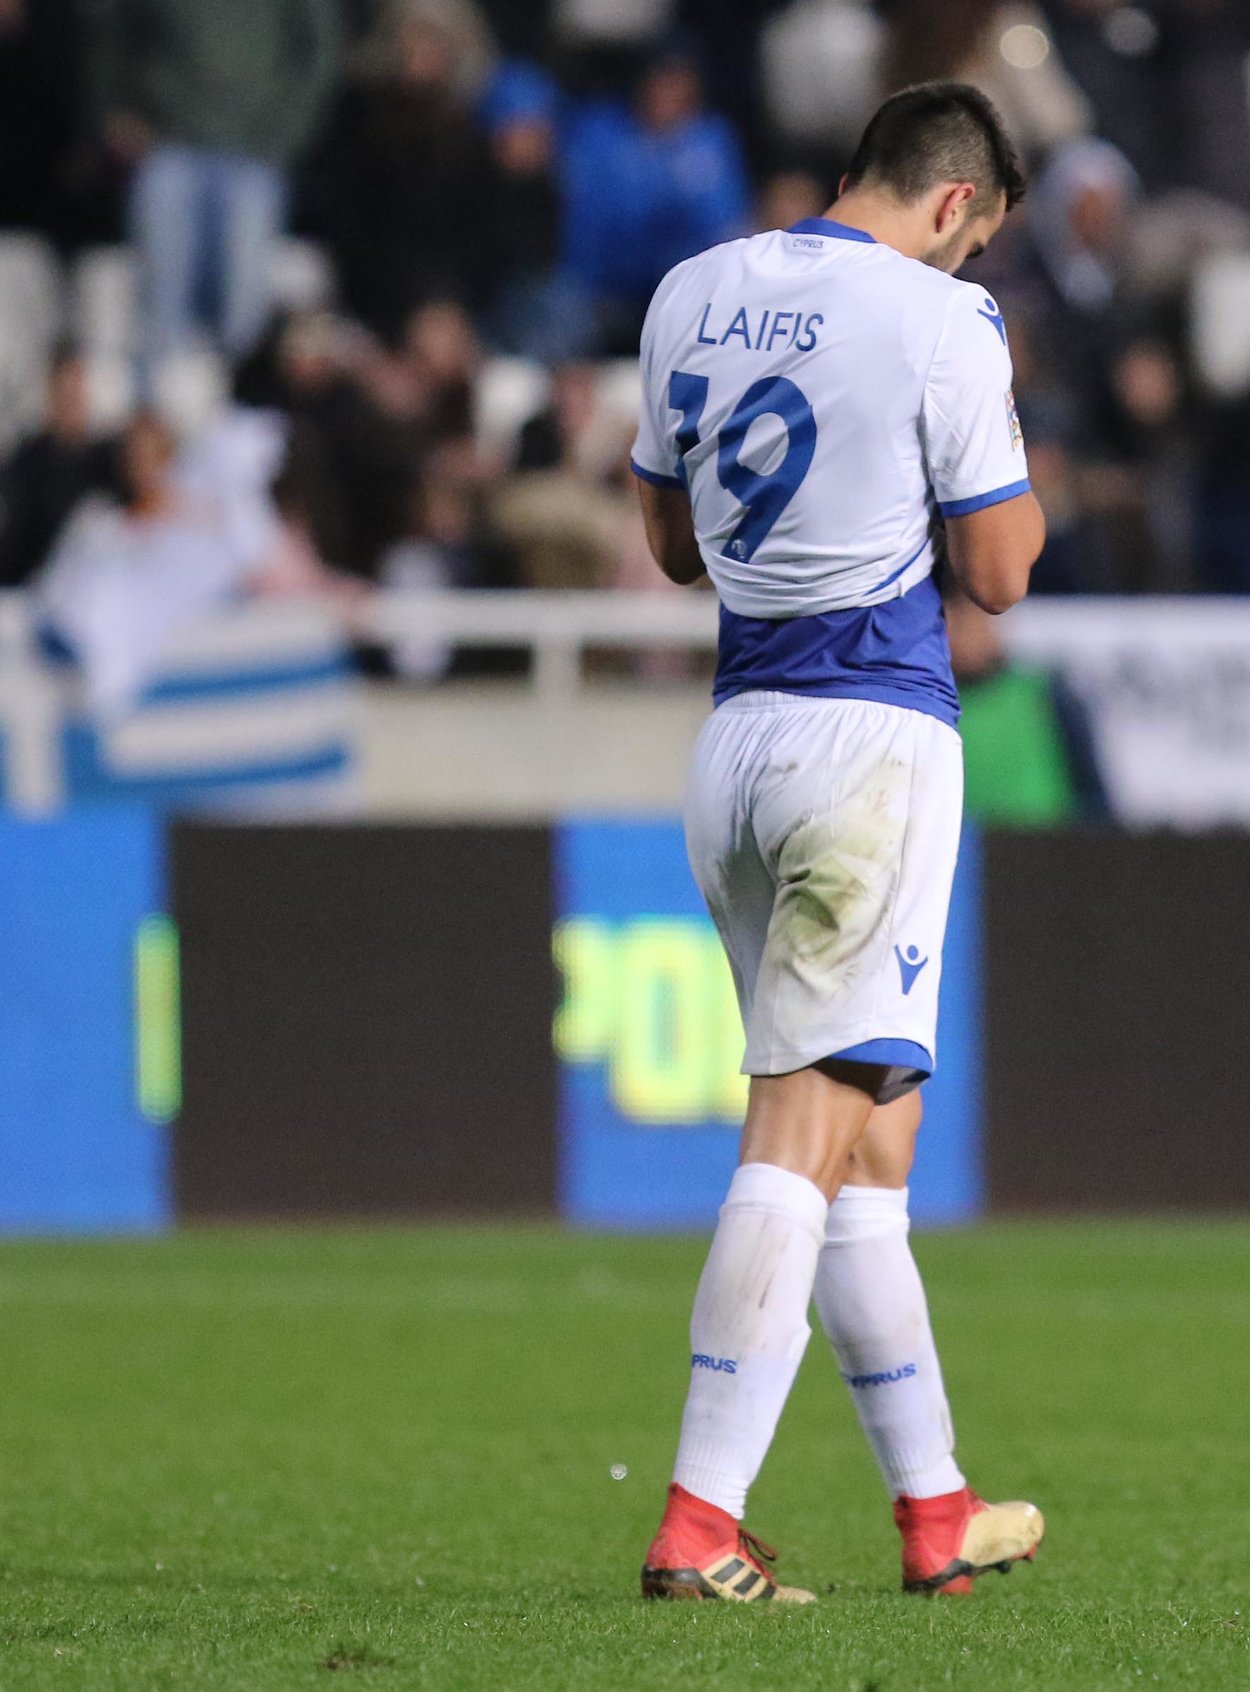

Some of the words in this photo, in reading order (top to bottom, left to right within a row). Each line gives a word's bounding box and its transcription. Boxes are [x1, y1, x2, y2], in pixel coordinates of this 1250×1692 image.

[792, 239, 825, 249] CYPRUS
[697, 302, 824, 352] LAIFIS
[668, 369, 817, 565] 19
[691, 1353, 738, 1374] PRUS
